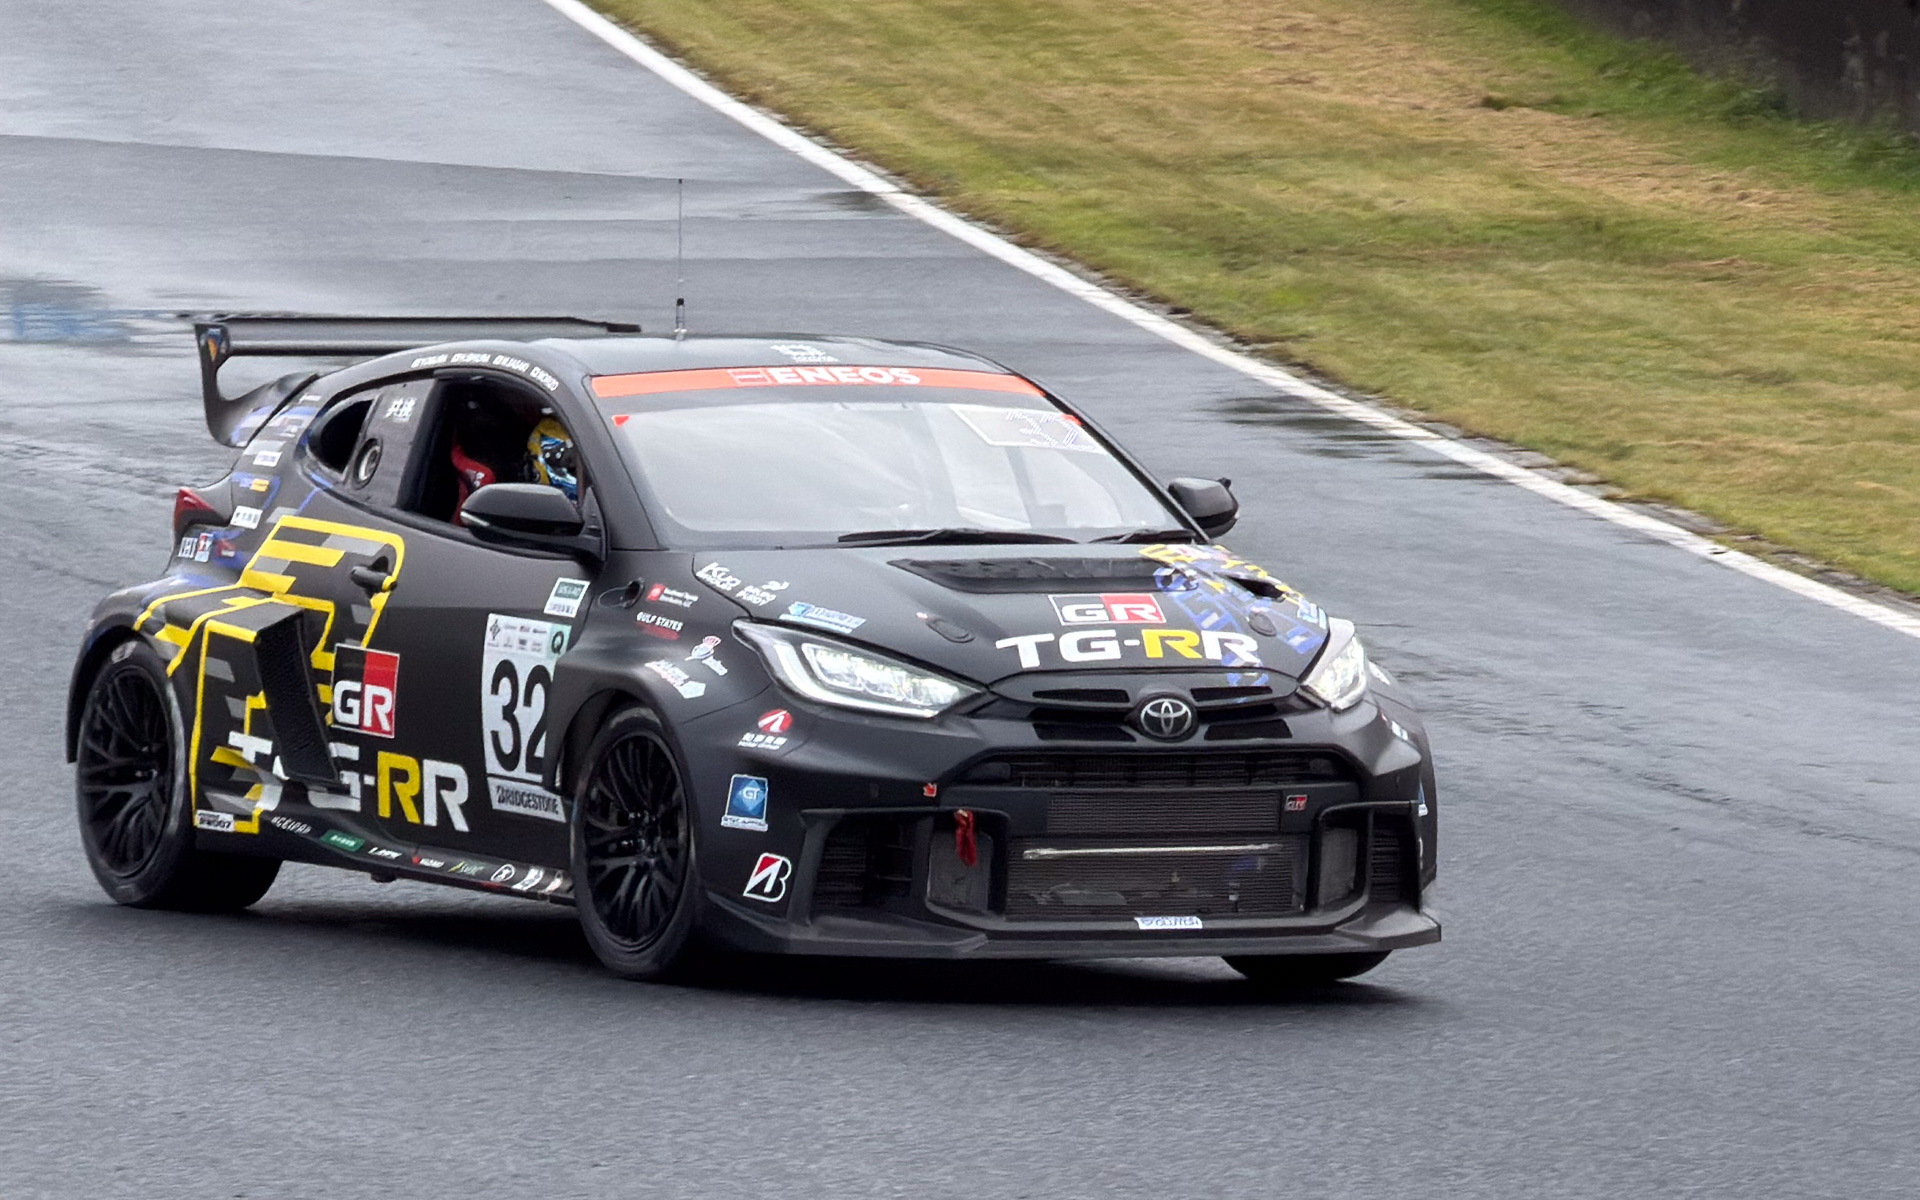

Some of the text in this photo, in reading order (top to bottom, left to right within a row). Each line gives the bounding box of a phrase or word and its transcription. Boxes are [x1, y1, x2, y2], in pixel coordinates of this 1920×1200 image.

[767, 366, 921, 385] ENEOS
[1060, 601, 1163, 623] GR
[551, 630, 565, 655] Q
[995, 628, 1259, 669] TG-RR
[333, 679, 395, 733] GR
[490, 659, 553, 776] 32
[496, 784, 560, 815] BRIDGESTONE
[742, 787, 761, 799] GT
